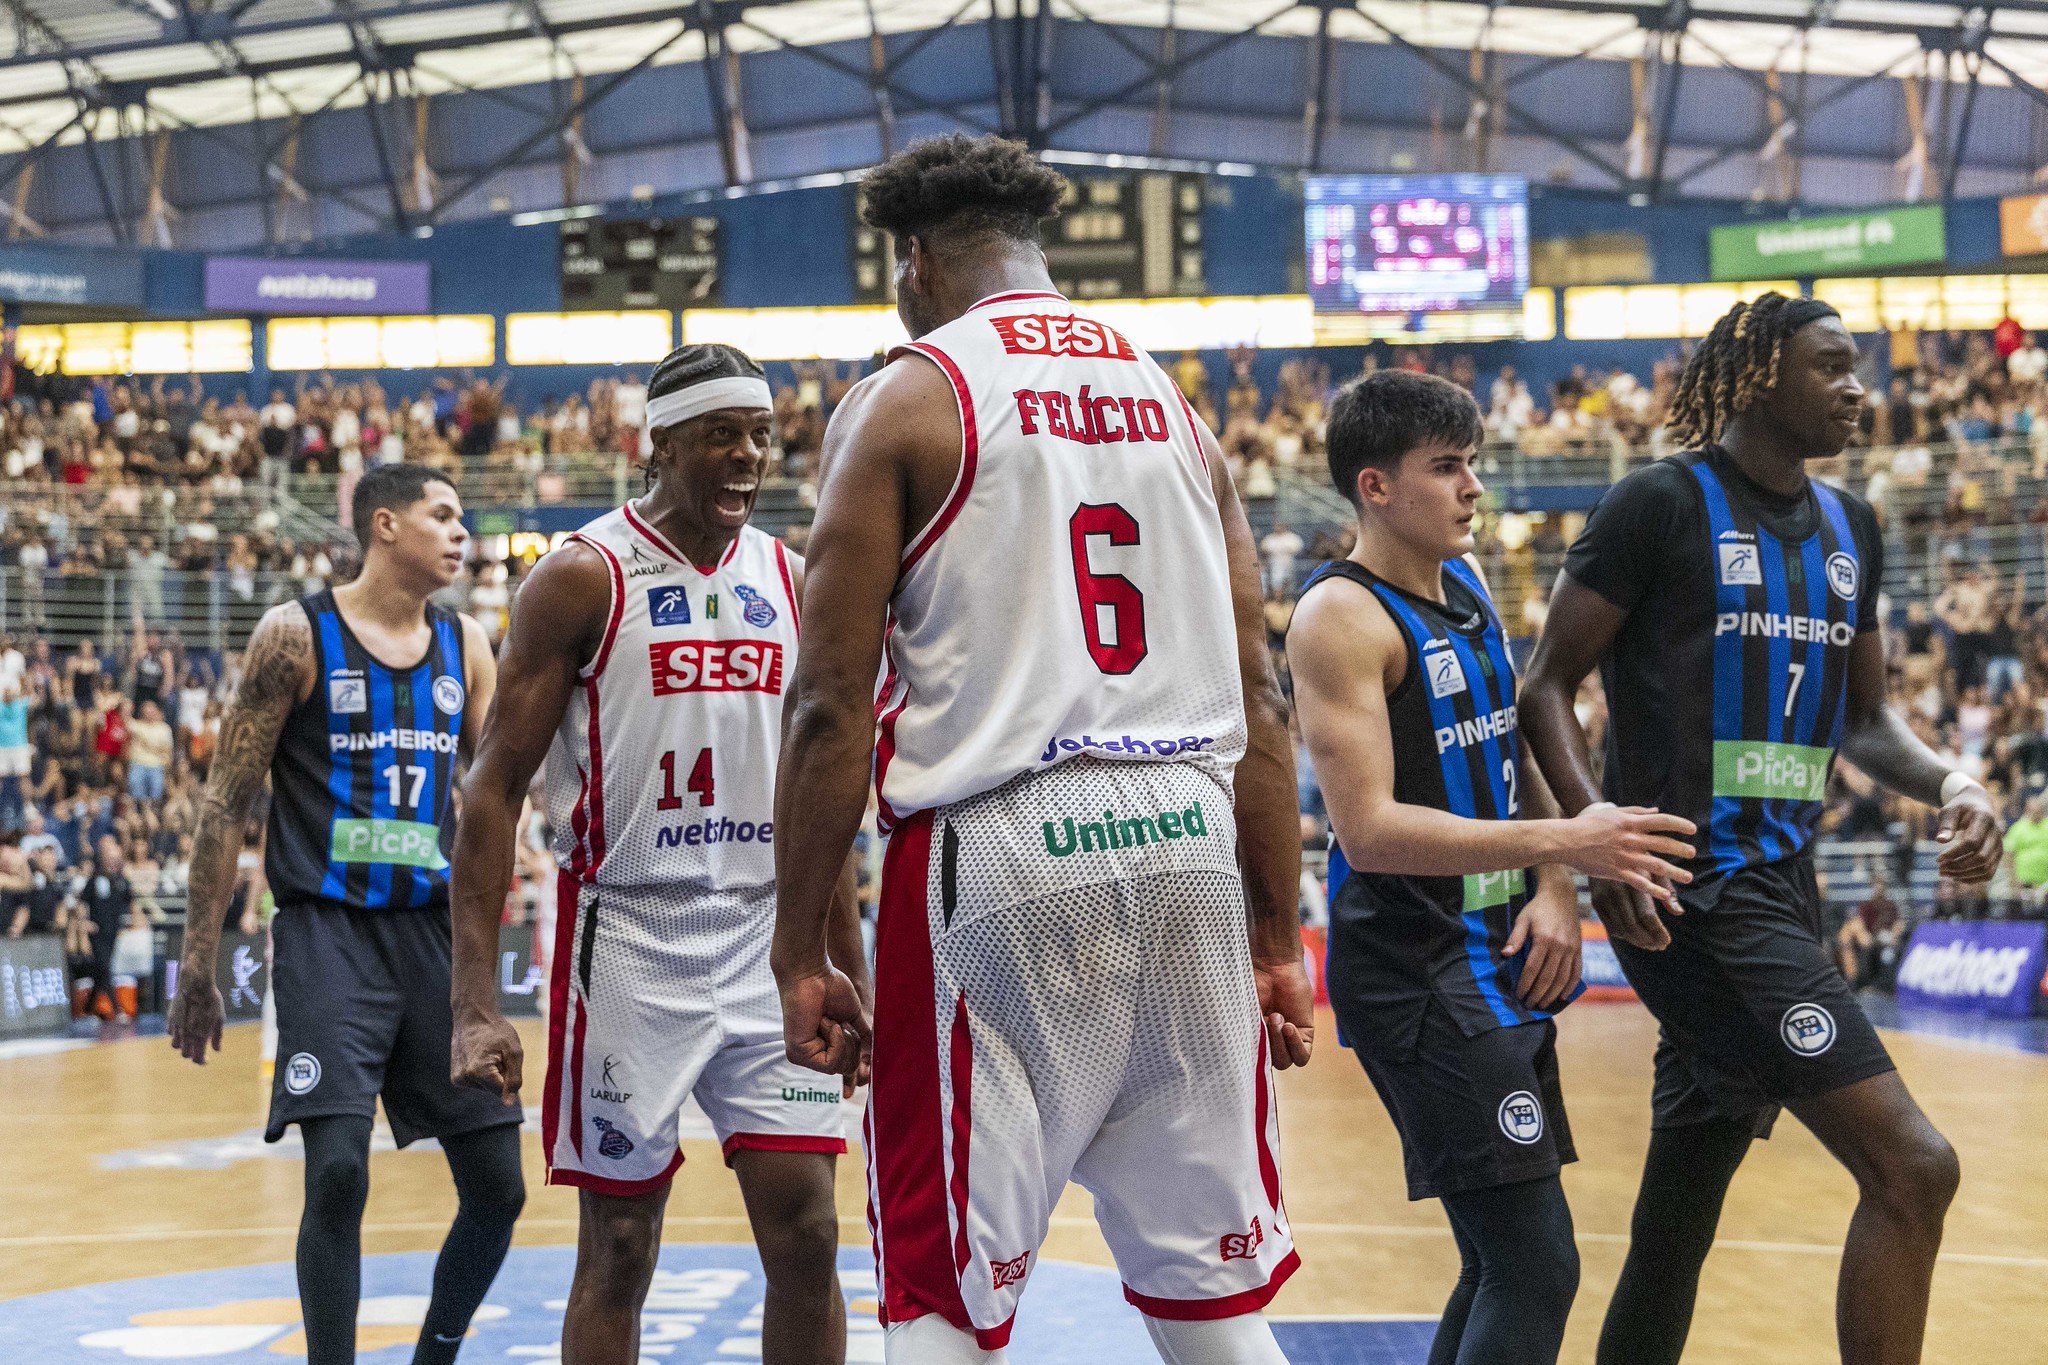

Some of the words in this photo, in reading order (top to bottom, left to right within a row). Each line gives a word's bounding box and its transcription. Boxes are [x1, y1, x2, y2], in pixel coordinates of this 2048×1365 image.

[1013, 318, 1118, 355] SESI
[1013, 385, 1169, 445] FELÍCIO
[629, 563, 666, 578] LARULP
[1069, 502, 1148, 675] 6
[666, 646, 773, 689] SESI
[1784, 663, 1805, 717] 7
[1435, 705, 1518, 755] PINHEIR
[383, 764, 427, 808] 17
[657, 747, 714, 811] 14
[1737, 746, 1827, 798] PicPay
[348, 821, 433, 858] PicPa
[1042, 801, 1208, 857] Unimed
[591, 1088, 632, 1103] LARULP
